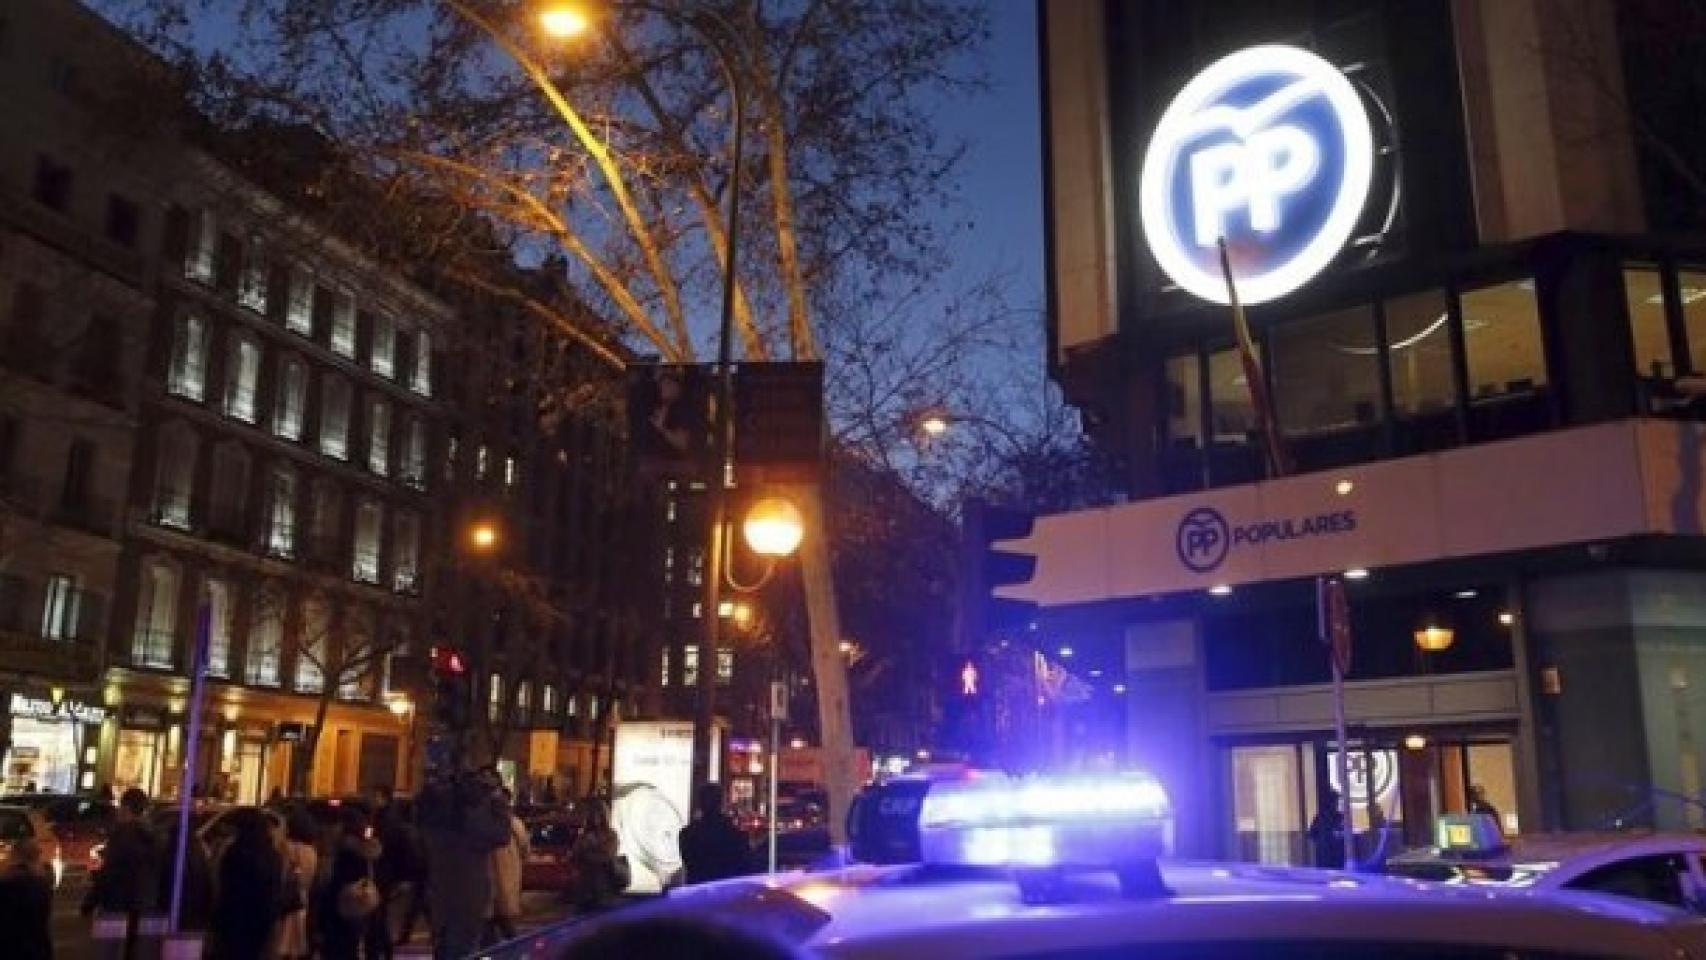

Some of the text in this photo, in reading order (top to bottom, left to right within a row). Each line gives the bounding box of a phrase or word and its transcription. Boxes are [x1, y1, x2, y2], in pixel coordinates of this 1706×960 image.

[1191, 126, 1321, 248] PP
[1187, 511, 1357, 557] PP POPULARES
